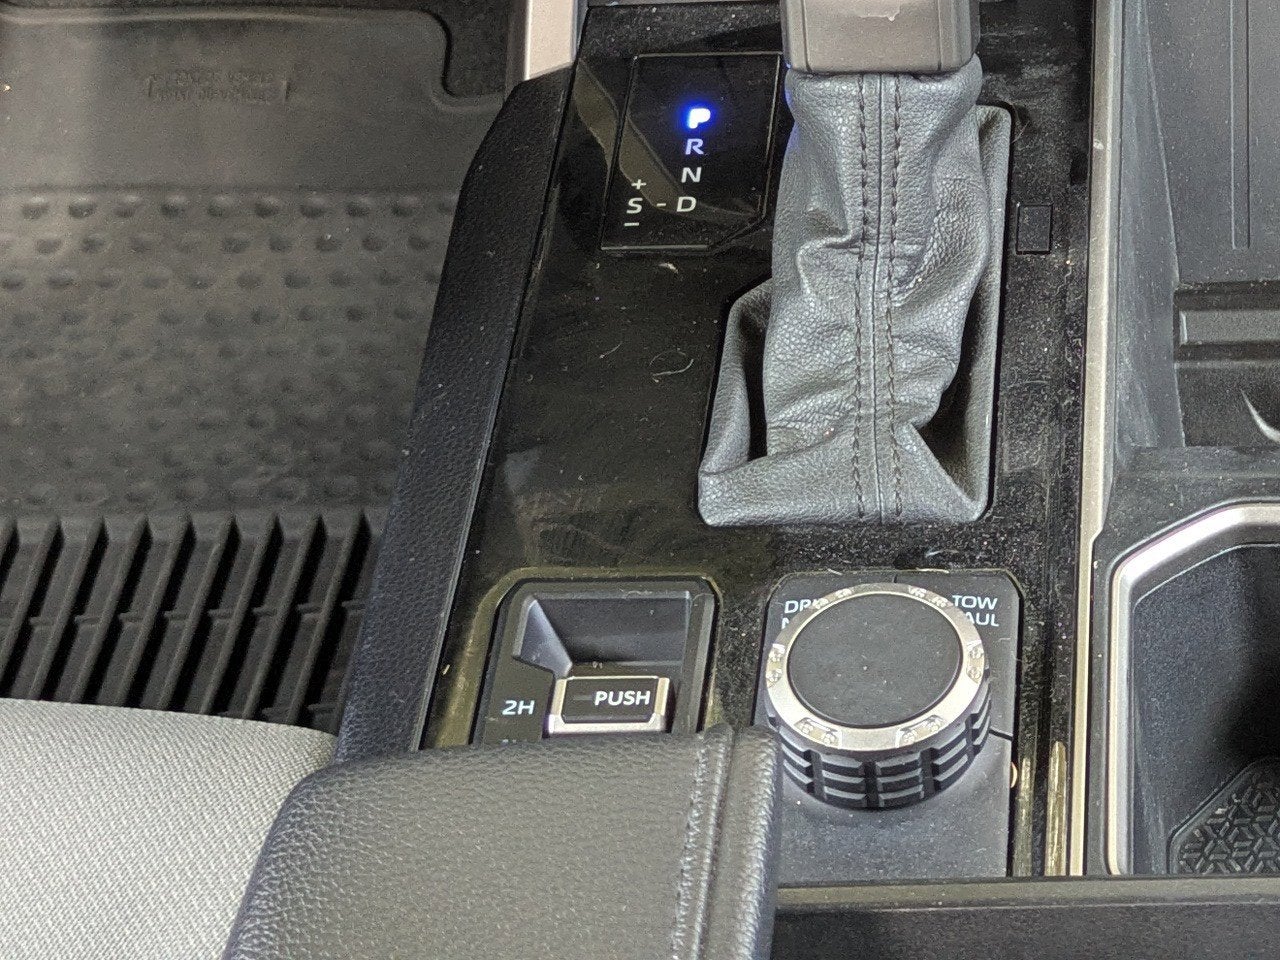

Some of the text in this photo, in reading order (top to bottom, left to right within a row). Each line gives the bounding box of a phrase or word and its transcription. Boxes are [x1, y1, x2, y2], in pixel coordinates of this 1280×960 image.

[687, 108, 711, 129] P
[685, 138, 704, 155] R
[681, 166, 702, 183] N
[626, 197, 643, 214] S
[676, 196, 697, 213] D
[952, 594, 998, 611] TOW
[965, 611, 1000, 628] AUL
[594, 690, 651, 706] PUSH
[502, 699, 535, 716] 2H
